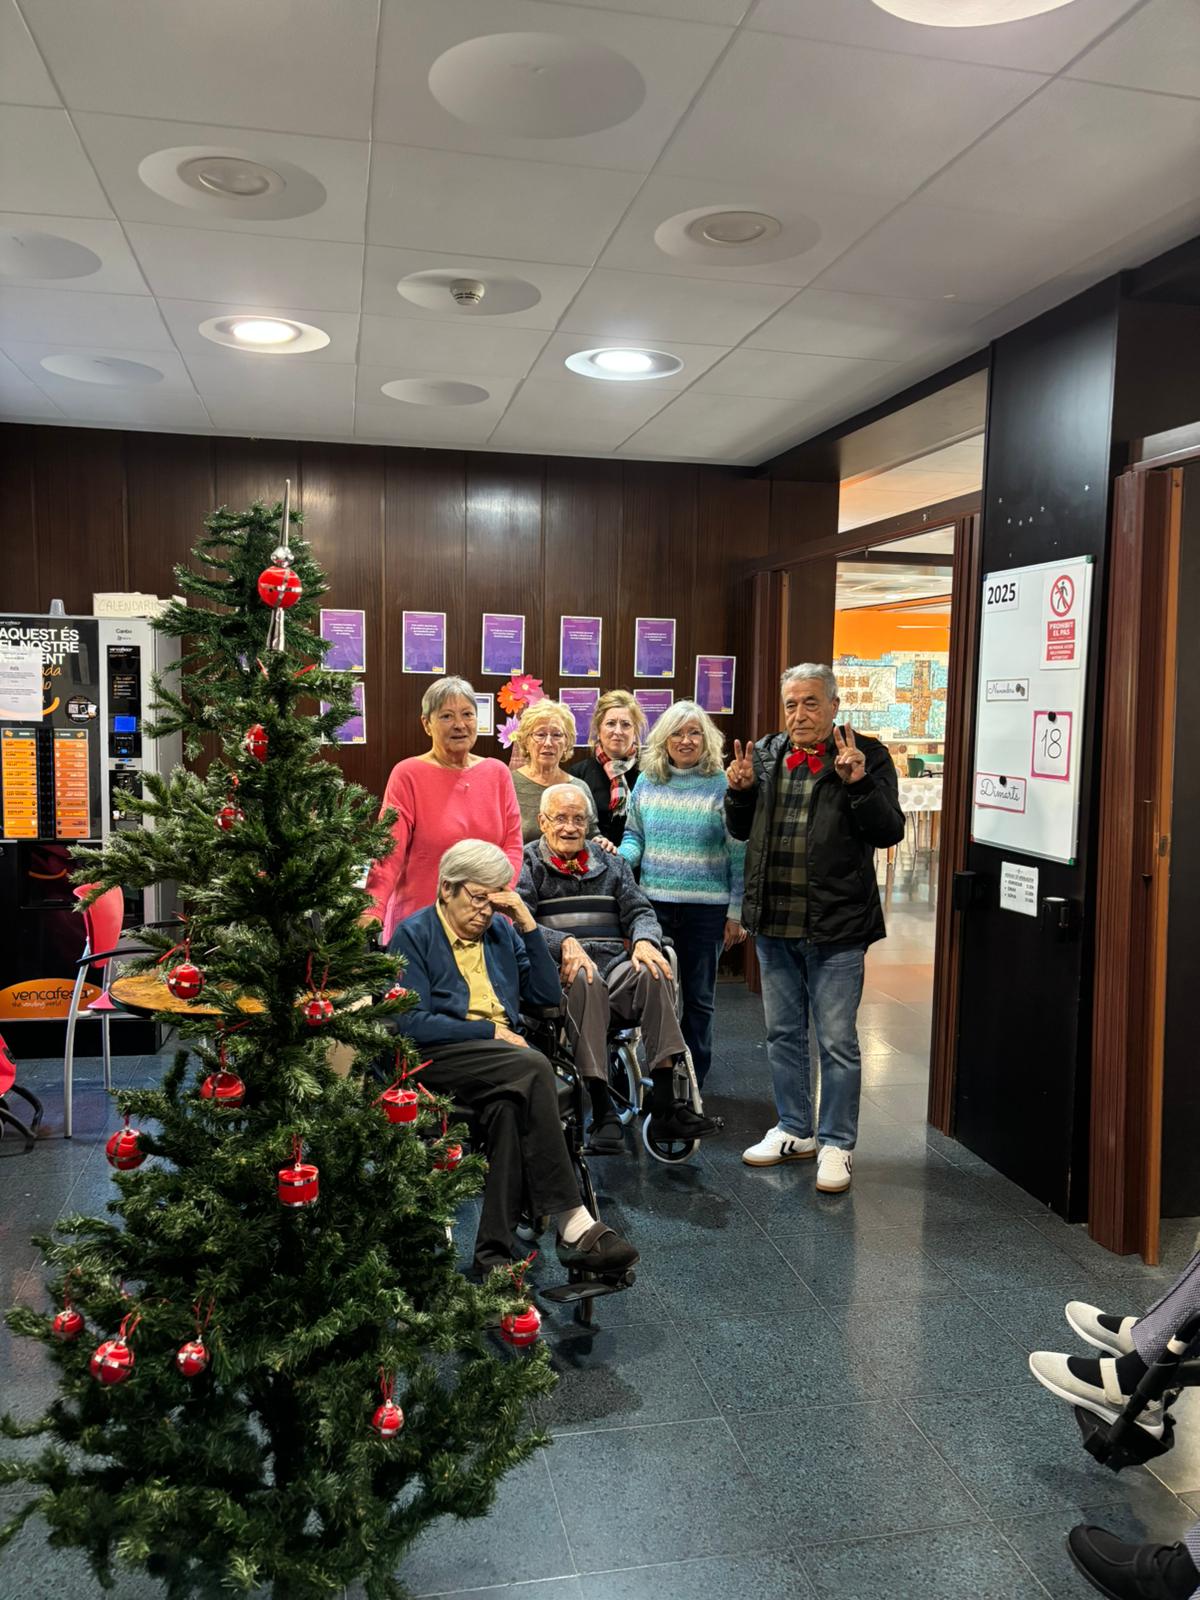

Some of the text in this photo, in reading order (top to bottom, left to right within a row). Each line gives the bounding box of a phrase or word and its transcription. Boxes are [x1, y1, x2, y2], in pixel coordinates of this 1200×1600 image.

[987, 583, 1016, 605] 2025
[0, 627, 80, 641] AQUEST ÉS
[20, 641, 79, 653] NOSTRE
[1041, 728, 1062, 759] 18
[980, 778, 1020, 801] Dimarts
